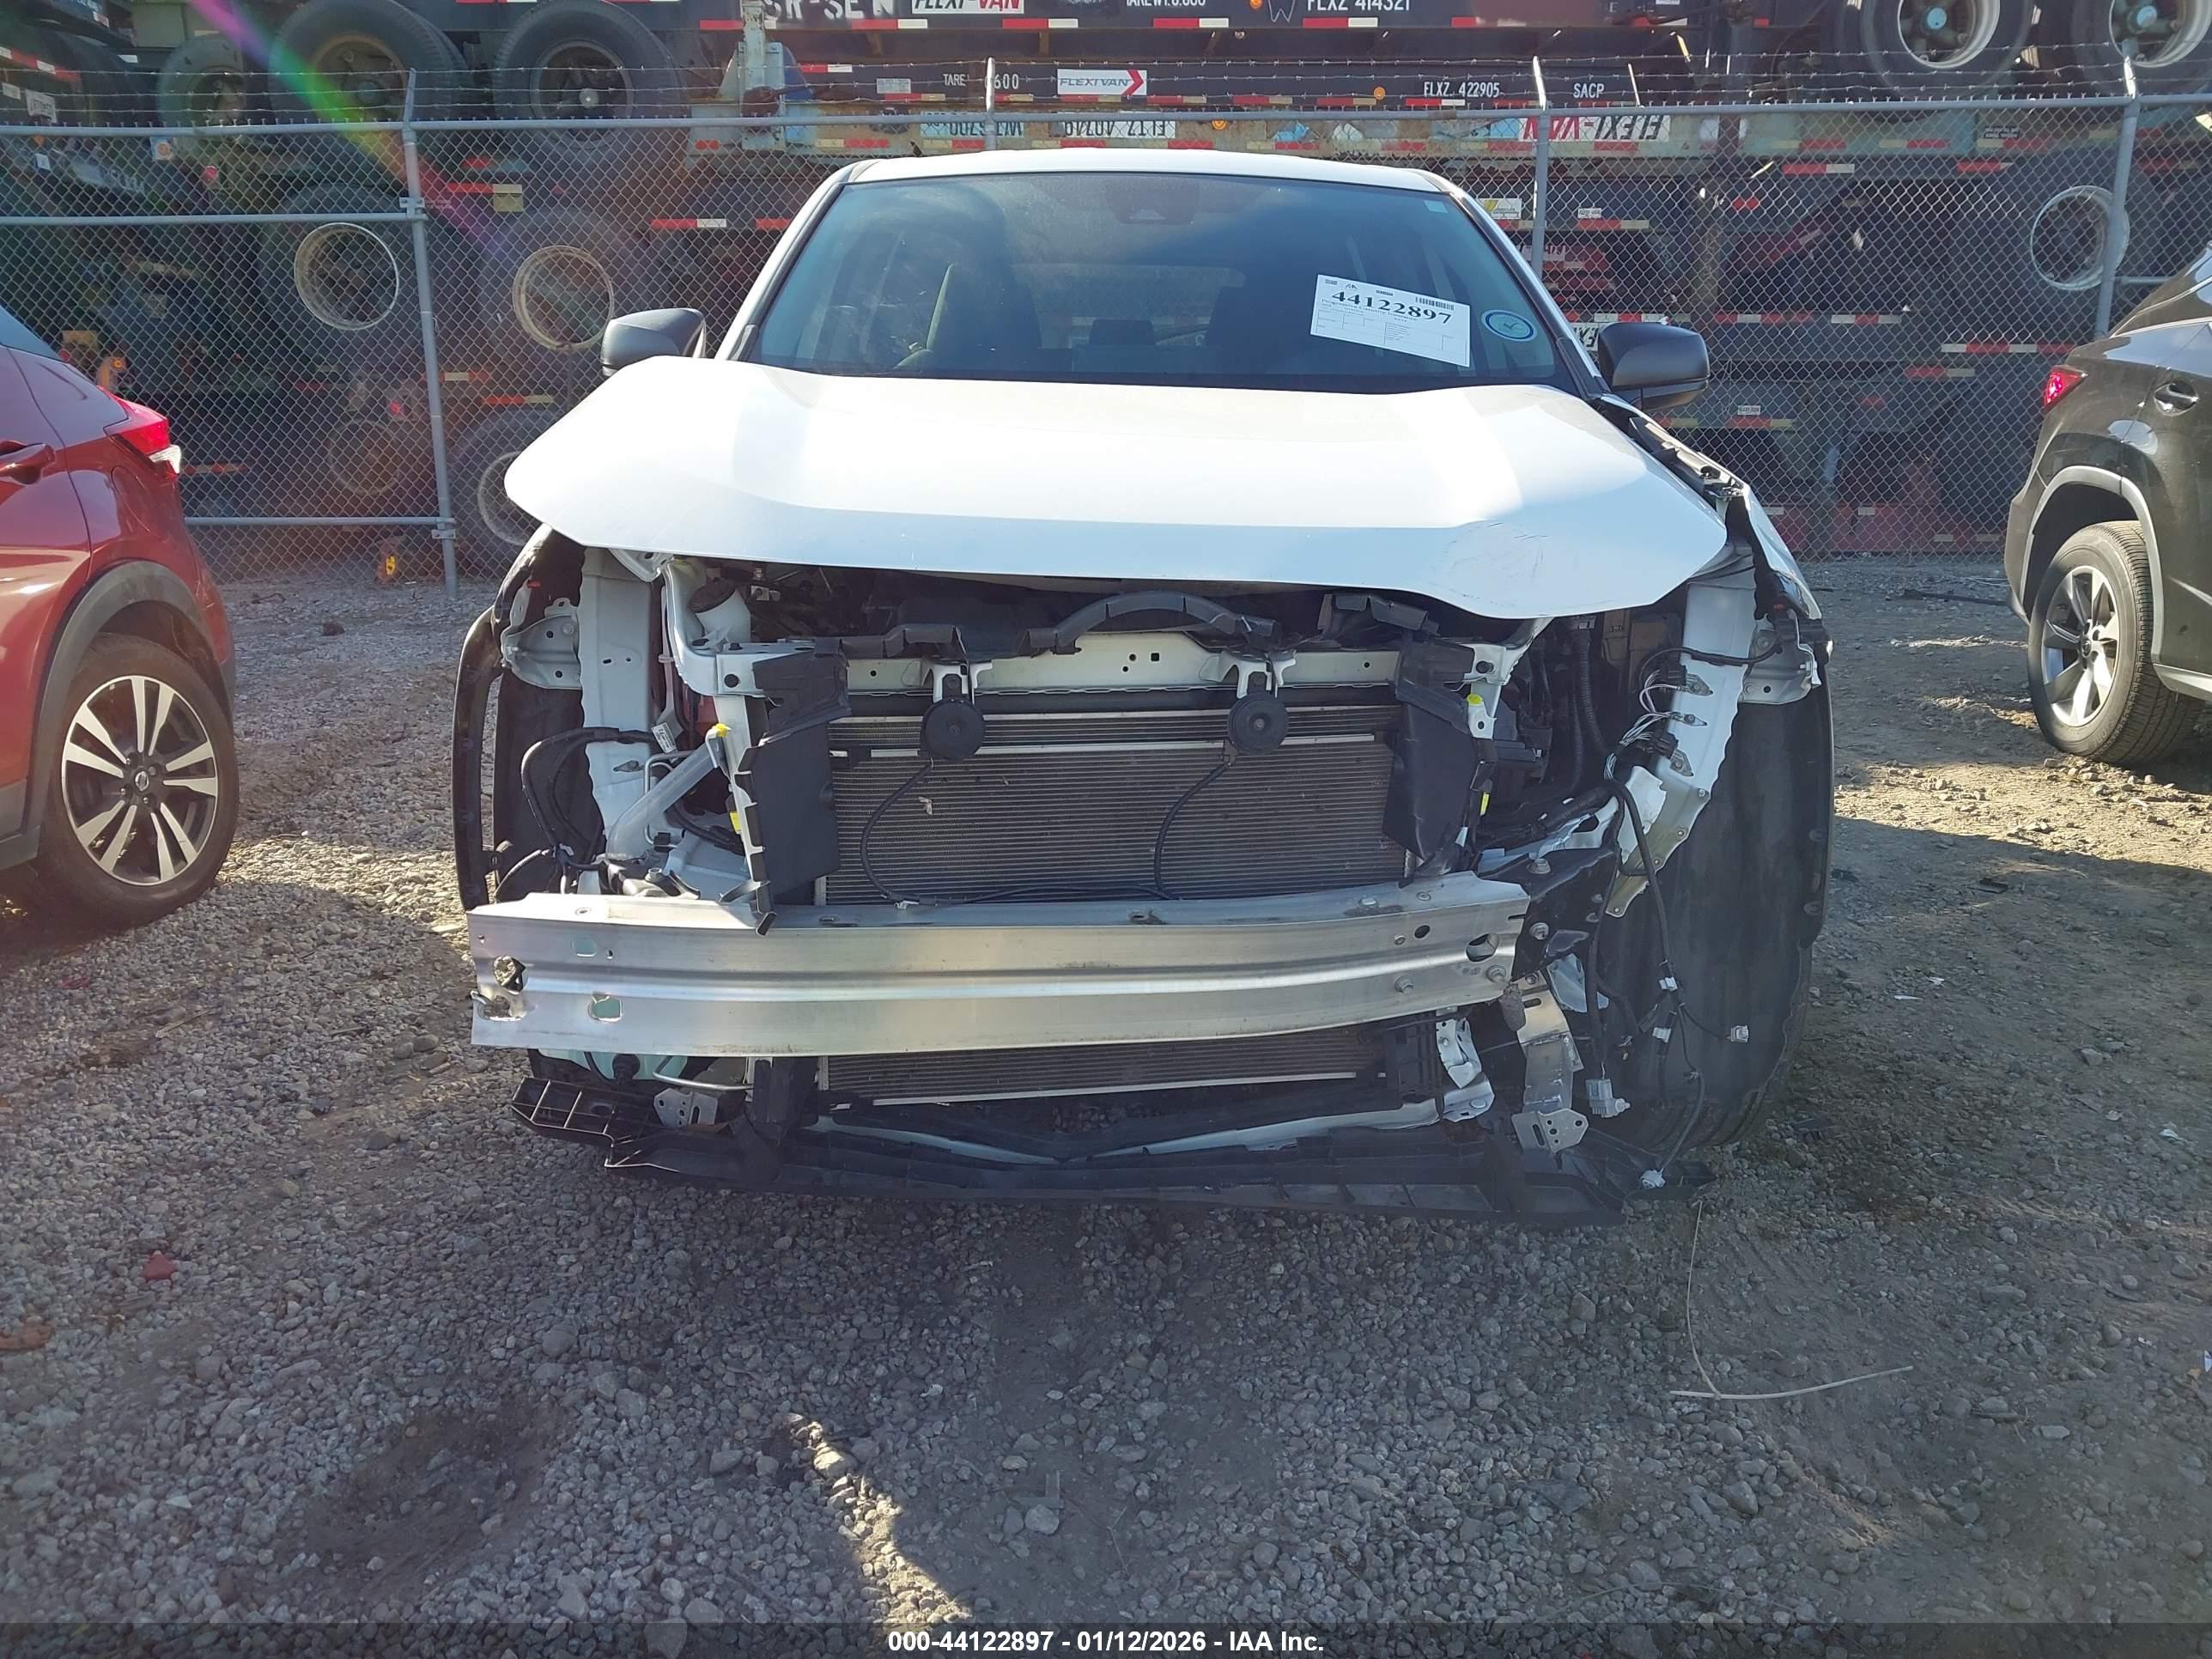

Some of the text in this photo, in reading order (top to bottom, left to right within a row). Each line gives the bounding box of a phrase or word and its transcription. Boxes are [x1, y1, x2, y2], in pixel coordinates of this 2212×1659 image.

[984, 74, 1019, 90] 600
[1458, 82, 1500, 98] 422905
[1332, 290, 1453, 325] 44122897
